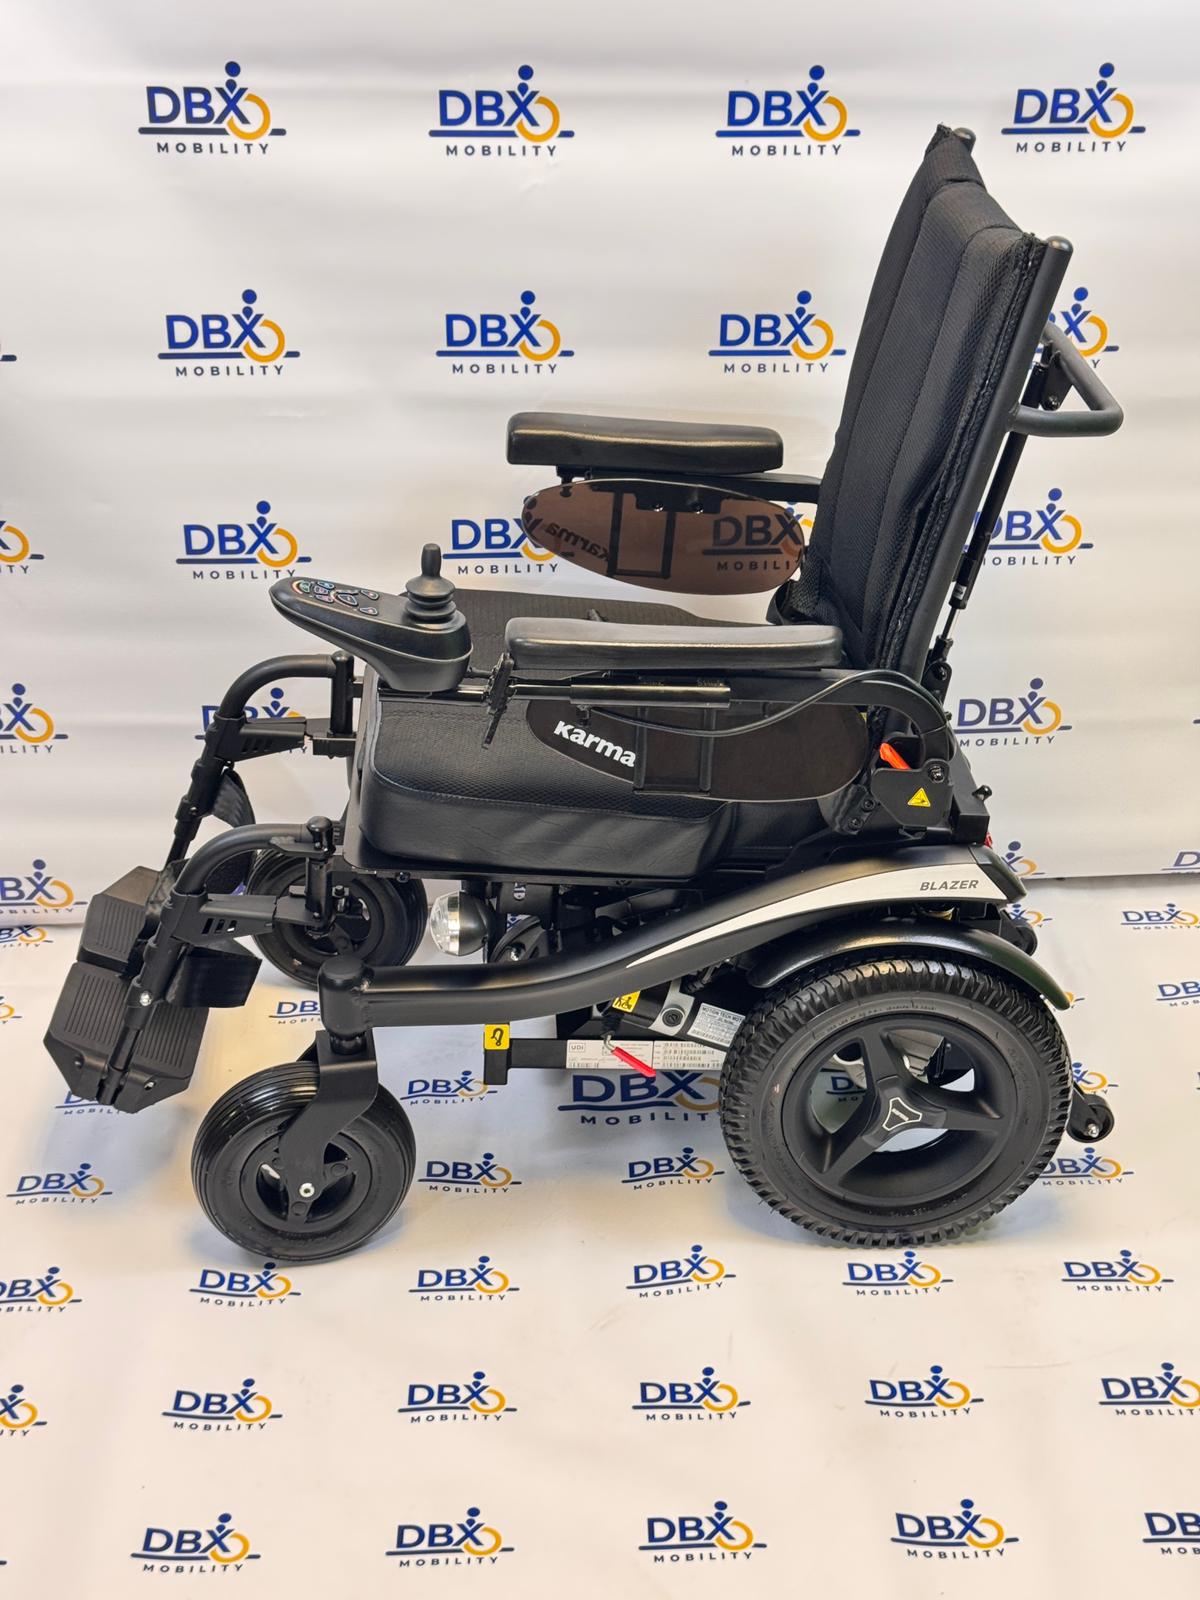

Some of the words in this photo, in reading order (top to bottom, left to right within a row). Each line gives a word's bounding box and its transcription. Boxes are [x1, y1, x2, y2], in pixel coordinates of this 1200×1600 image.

[146, 86, 250, 124] DBX
[439, 90, 539, 126] DBX
[727, 91, 828, 126] DBX
[1014, 88, 1117, 124] DBX
[157, 142, 268, 154] MOBILITY
[446, 145, 556, 156] MOBILITY
[732, 144, 841, 156] MOBILITY
[1016, 141, 1126, 153] MOBILITY
[166, 314, 265, 349] DBX
[446, 314, 541, 347] DBX
[720, 314, 815, 346] DBX
[176, 365, 283, 376] MOBILITY
[452, 364, 557, 374] MOBILITY
[724, 363, 828, 373] MOBILITY
[183, 523, 278, 555] DBX
[458, 563, 558, 574] MOBILITY
[717, 560, 791, 571] MOBILI
[193, 568, 296, 580] MOBILITY
[957, 697, 1046, 727] DBX
[553, 720, 637, 767] karma
[960, 736, 1055, 748] MOBILITY
[0, 877, 56, 900] BX
[920, 879, 979, 891] BLAZER
[1123, 911, 1185, 922] DBX
[0, 926, 36, 939] BX
[1158, 981, 1200, 997] DB
[277, 1000, 319, 1015] DB
[408, 1079, 474, 1095] DBX
[573, 1071, 705, 1103] DBX
[410, 1096, 485, 1106] MOBILITY
[581, 1112, 708, 1125] MOBILIT
[426, 1161, 497, 1180] DBX
[628, 1159, 698, 1178] DBX
[17, 1173, 86, 1192] DBX
[429, 1185, 509, 1193] MOBILITY
[634, 1178, 712, 1190] MOBILITY
[1042, 1178, 1122, 1186] MOBILITY
[16, 1197, 98, 1205] MOBILITY
[634, 1256, 708, 1284] DBX
[848, 1262, 924, 1281] DBX
[1064, 1261, 1144, 1277] DBX
[199, 1269, 277, 1292] DBX
[418, 1268, 493, 1287] DBX
[639, 1282, 722, 1298] MOBILITY
[856, 1286, 941, 1296] MOBILITY
[200, 1297, 285, 1307] MOBILITY
[408, 1384, 489, 1406] DBX
[640, 1381, 721, 1403] DBX
[870, 1378, 953, 1401] DBX
[1101, 1376, 1188, 1399] DBX
[173, 1390, 257, 1414] DBX
[411, 1414, 502, 1423] MOBILITY
[646, 1411, 736, 1421] MOBILITY
[880, 1407, 970, 1418] MOBILITY
[174, 1422, 266, 1431] MOBILITY
[647, 1516, 735, 1543] DBX
[896, 1513, 986, 1540] DBX
[1145, 1512, 1200, 1536] DB
[142, 1528, 234, 1554] DBX
[396, 1523, 484, 1548] DBX
[654, 1552, 752, 1562] MOBILITY
[907, 1548, 1004, 1559] MOBILITY
[143, 1564, 243, 1573] MOBILITY
[399, 1557, 497, 1567] MOBILITY
